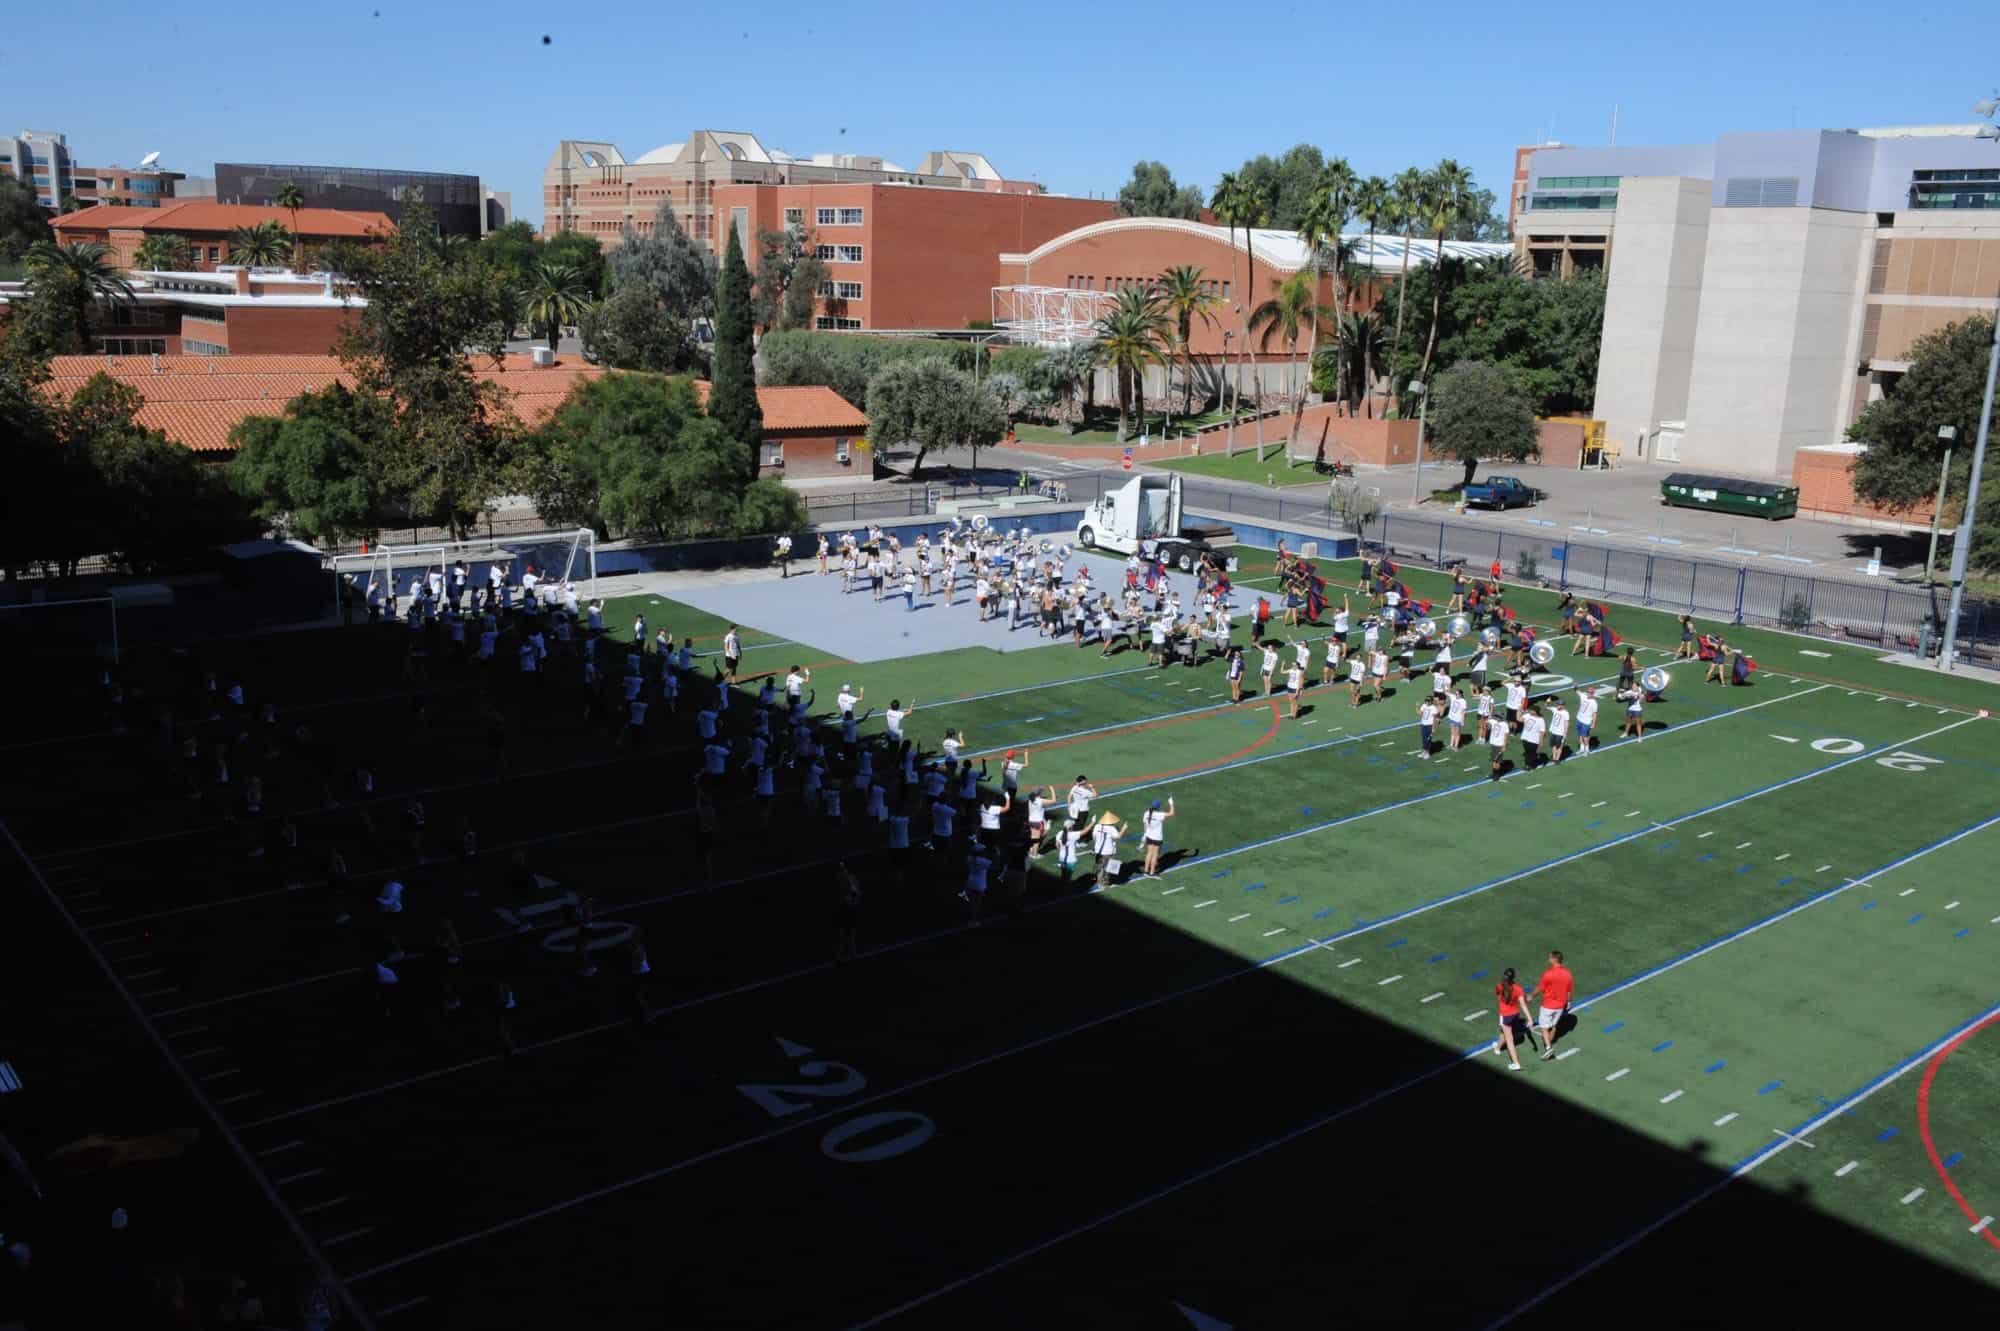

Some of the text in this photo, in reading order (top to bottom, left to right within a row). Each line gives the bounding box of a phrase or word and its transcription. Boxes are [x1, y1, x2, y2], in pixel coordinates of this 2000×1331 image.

[1811, 738, 1944, 771] 20
[491, 889, 640, 952] 10
[736, 1060, 937, 1163] 20
